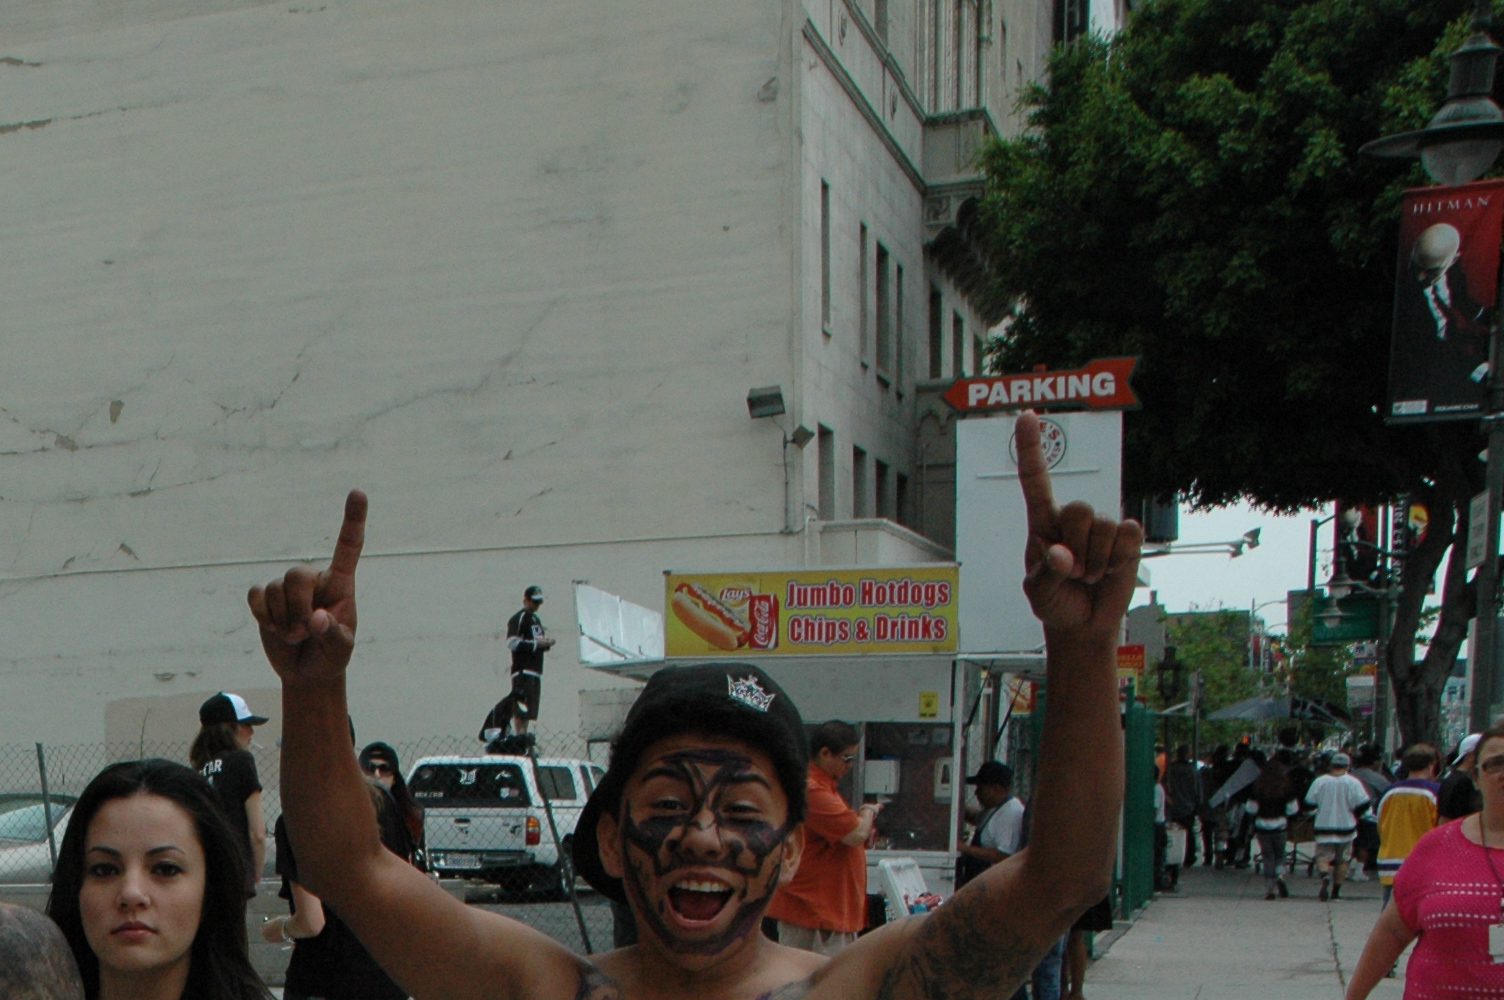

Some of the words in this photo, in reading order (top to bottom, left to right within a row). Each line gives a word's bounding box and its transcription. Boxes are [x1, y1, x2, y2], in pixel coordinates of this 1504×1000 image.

[1412, 195, 1491, 215] HITMAN
[967, 372, 1116, 407] PARKING
[786, 580, 857, 608] Jumbo
[859, 578, 951, 608] Hotdogs
[788, 614, 852, 645] Chips
[854, 620, 871, 642] &
[874, 614, 948, 642] Drinks
